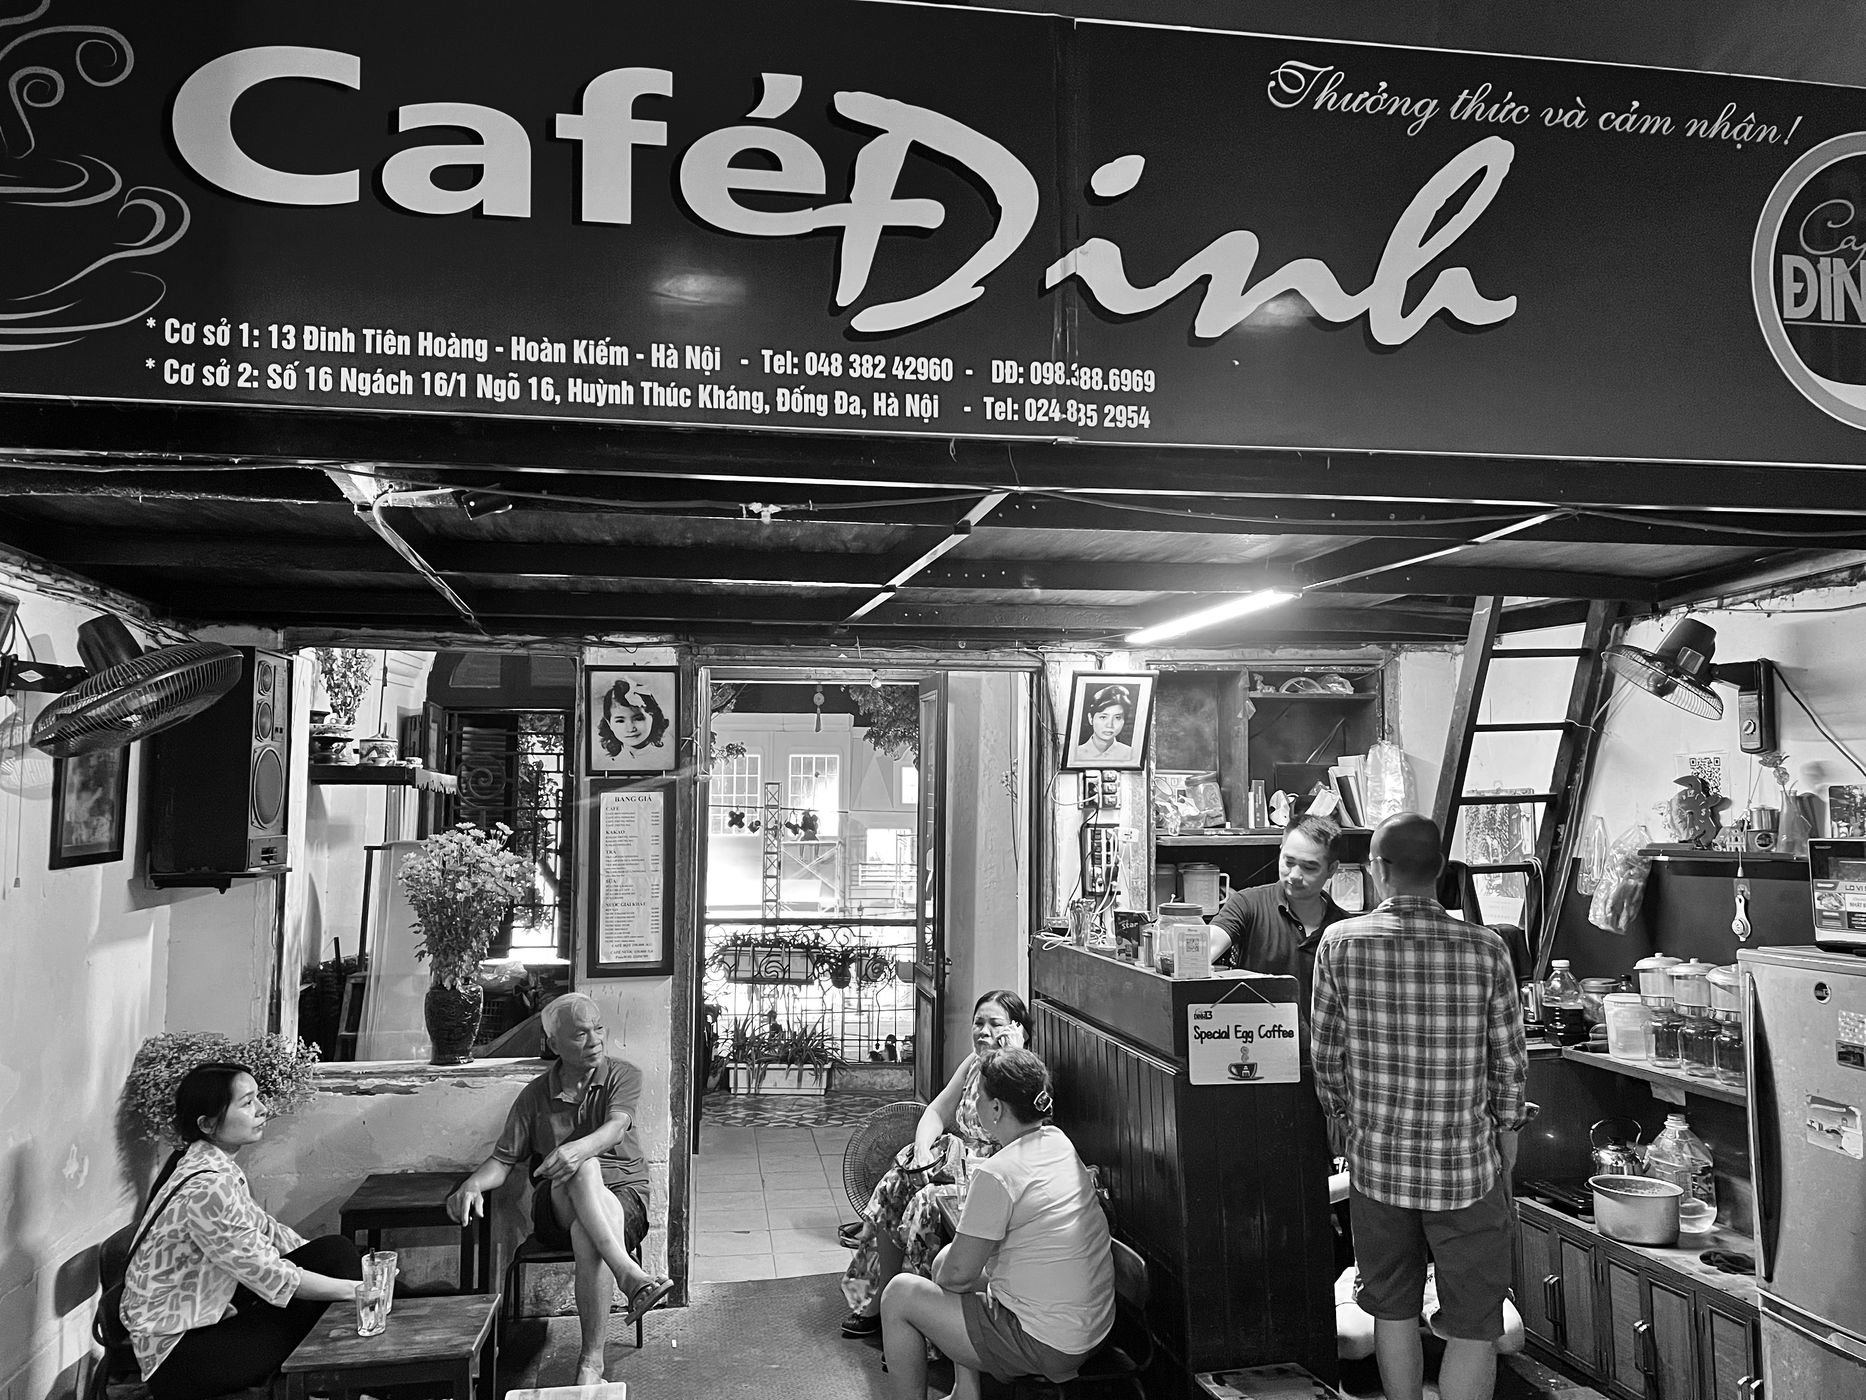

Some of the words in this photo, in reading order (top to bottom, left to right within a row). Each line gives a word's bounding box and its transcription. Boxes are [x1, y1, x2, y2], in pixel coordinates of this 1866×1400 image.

[1267, 60, 1440, 137] Thưởng
[1450, 82, 1530, 124] thức
[1539, 95, 1589, 129] và
[1598, 100, 1676, 136] cảm
[1684, 102, 1804, 150] nhận!
[171, 45, 826, 236] Café
[812, 90, 1518, 346] Đinh
[163, 357, 195, 385] Cơ
[202, 358, 231, 387] sở
[237, 362, 259, 388] 2:
[266, 361, 301, 390] Số
[305, 366, 333, 392] 16
[340, 367, 413, 396] Ngách
[421, 371, 467, 398] 16/1
[476, 373, 520, 402] Ngõ
[528, 376, 561, 405] 16,
[567, 377, 634, 407] Huỳnh
[640, 381, 691, 408] Thúc
[698, 384, 770, 414] Kháng,
[776, 385, 828, 417] Đống
[834, 390, 867, 419] Đa,
[873, 392, 899, 417] Hà
[905, 393, 939, 423] Nội
[983, 396, 1019, 421] Tel:
[1024, 398, 1060, 422] 024
[1103, 403, 1151, 429] 2954
[164, 317, 197, 345] Cơ
[202, 317, 231, 347] sở
[239, 322, 260, 348] 1:
[267, 323, 296, 350] 13
[302, 325, 355, 353] Đinh
[362, 328, 411, 356] Tiên
[418, 331, 488, 363] Hoàng
[511, 336, 566, 363] Hoàn
[573, 336, 629, 366] Kiếm
[651, 343, 678, 369] Hà
[685, 345, 721, 376] Nội
[761, 349, 799, 375] Tel:
[805, 351, 843, 377] 048
[849, 354, 886, 379] 382
[892, 356, 953, 382] 42960
[991, 359, 1024, 384] DĐ:
[1030, 361, 1156, 393] 098.388.6969
[1193, 1025, 1230, 1044] Special
[1234, 1025, 1255, 1043] Egg
[1258, 1024, 1295, 1039] Coffee
